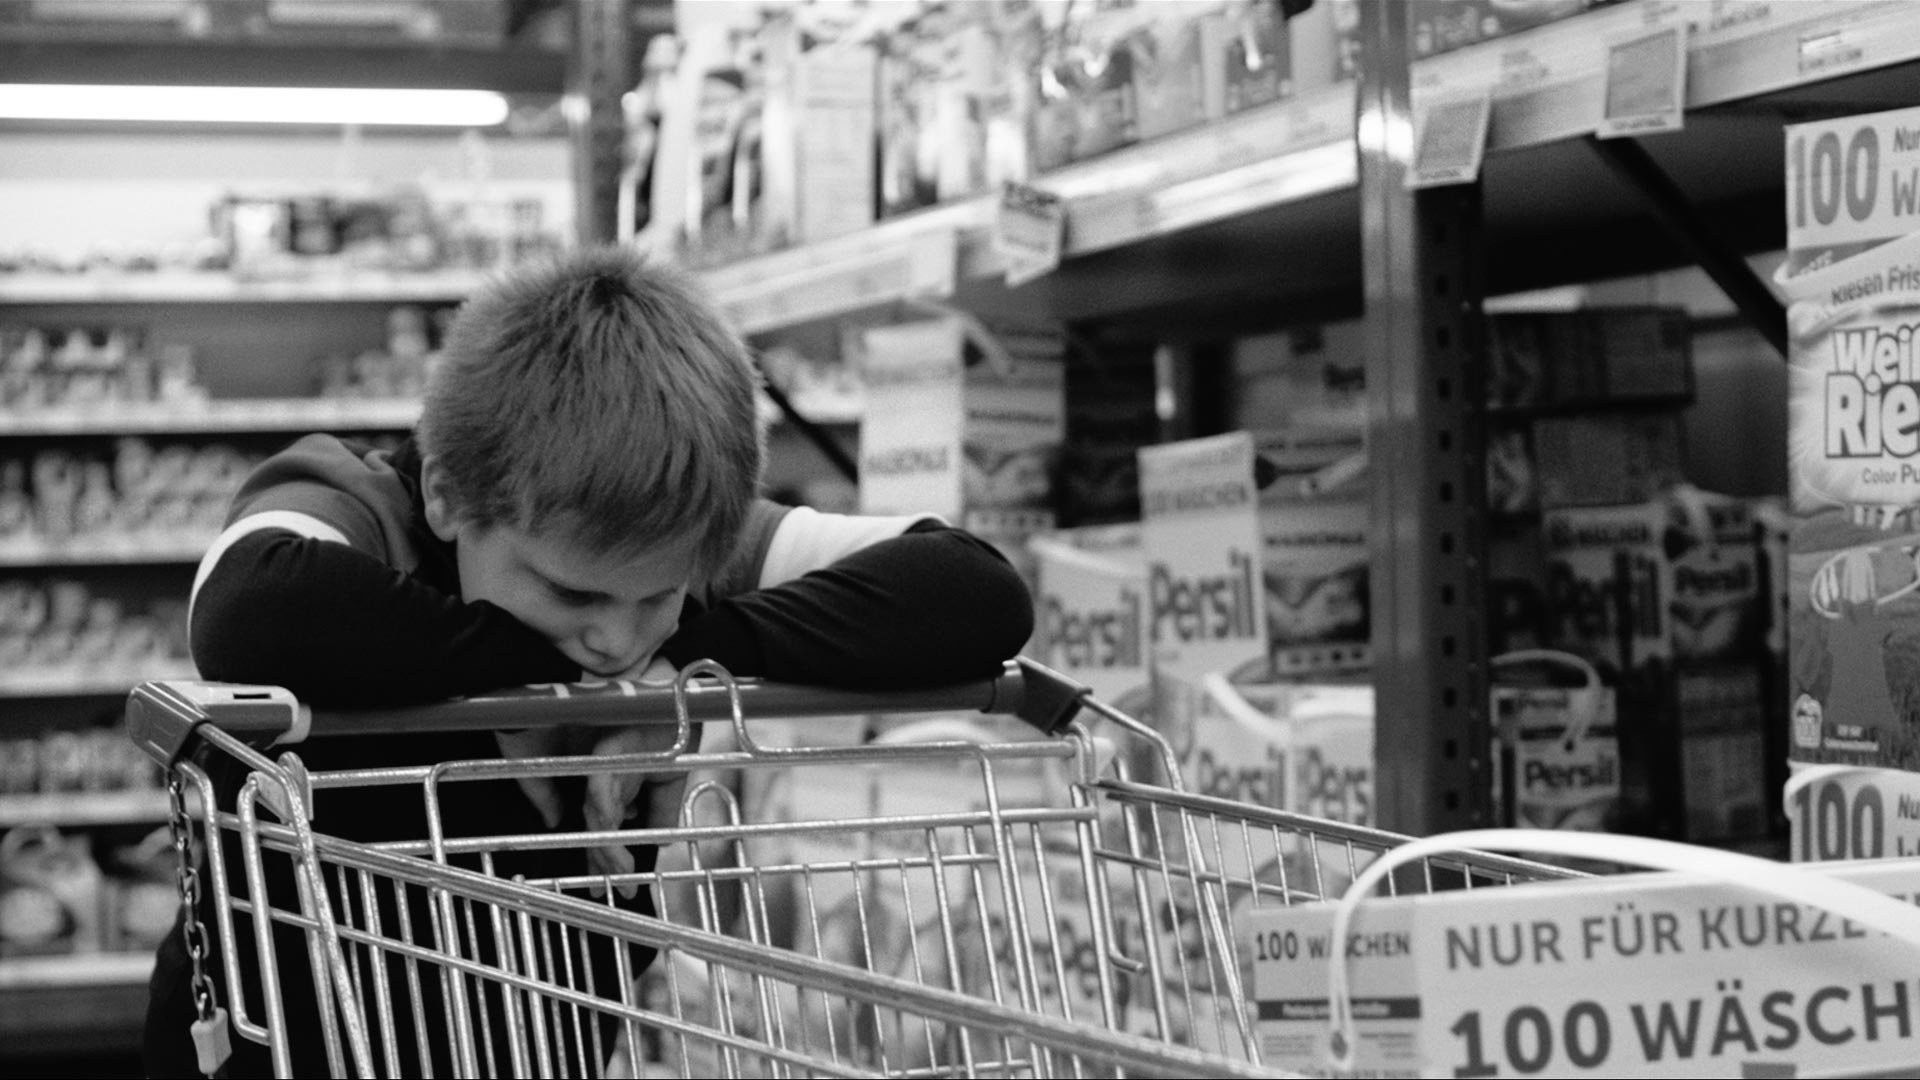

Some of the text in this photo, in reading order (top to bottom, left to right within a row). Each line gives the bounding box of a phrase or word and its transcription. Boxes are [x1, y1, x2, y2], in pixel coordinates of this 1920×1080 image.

[1790, 127, 1880, 229] 100
[1891, 166, 1920, 217] W
[1862, 466, 1898, 485] Color
[1050, 584, 1143, 668] Persil
[1147, 546, 1256, 644] Persil
[1523, 752, 1618, 795] Persil
[1796, 779, 1884, 862] 100
[1256, 930, 1411, 961] 100 WCHEN
[1446, 920, 1564, 971] NUR
[1582, 902, 1684, 960] FÜR
[1450, 977, 1920, 1079] 100 WÄSCH
